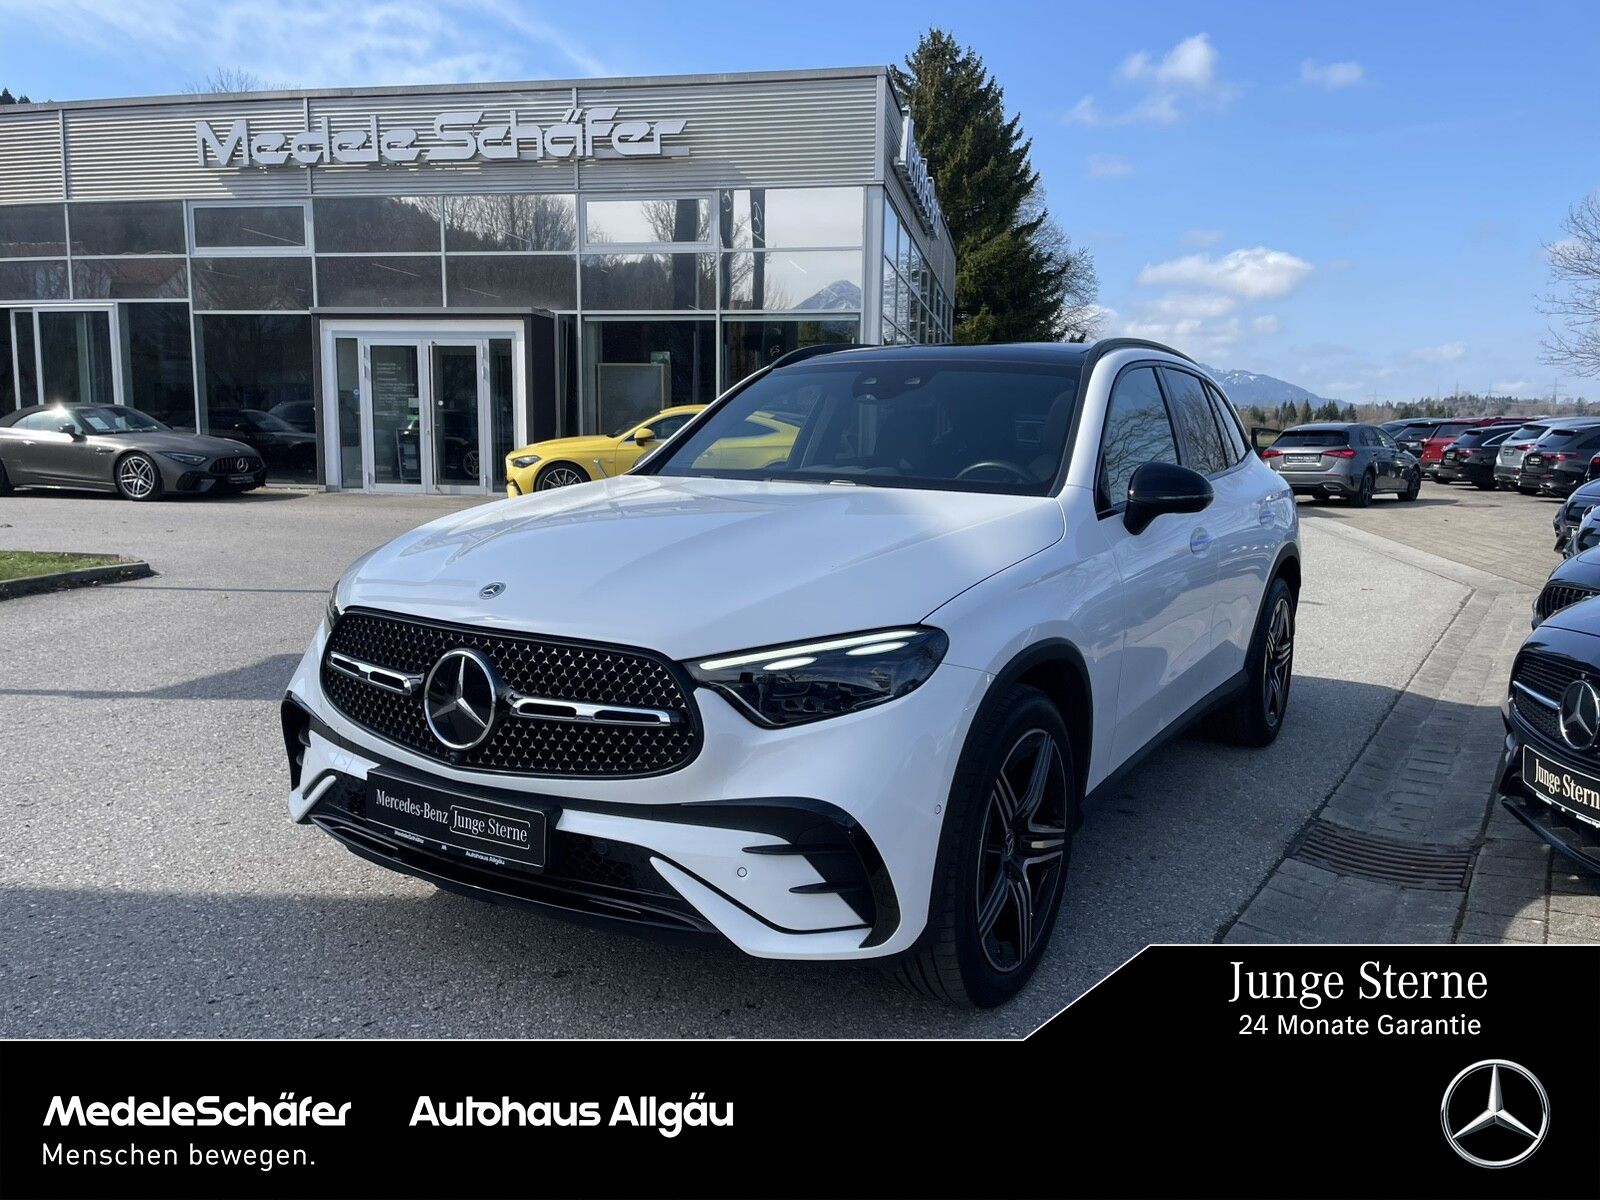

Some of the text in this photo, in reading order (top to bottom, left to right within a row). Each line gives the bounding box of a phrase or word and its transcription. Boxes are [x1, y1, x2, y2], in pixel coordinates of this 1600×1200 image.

[194, 107, 688, 168] MedeleSchäfer
[1534, 758, 1561, 795] Junge
[375, 788, 528, 843] Mercedes-Benz Junge Sterne
